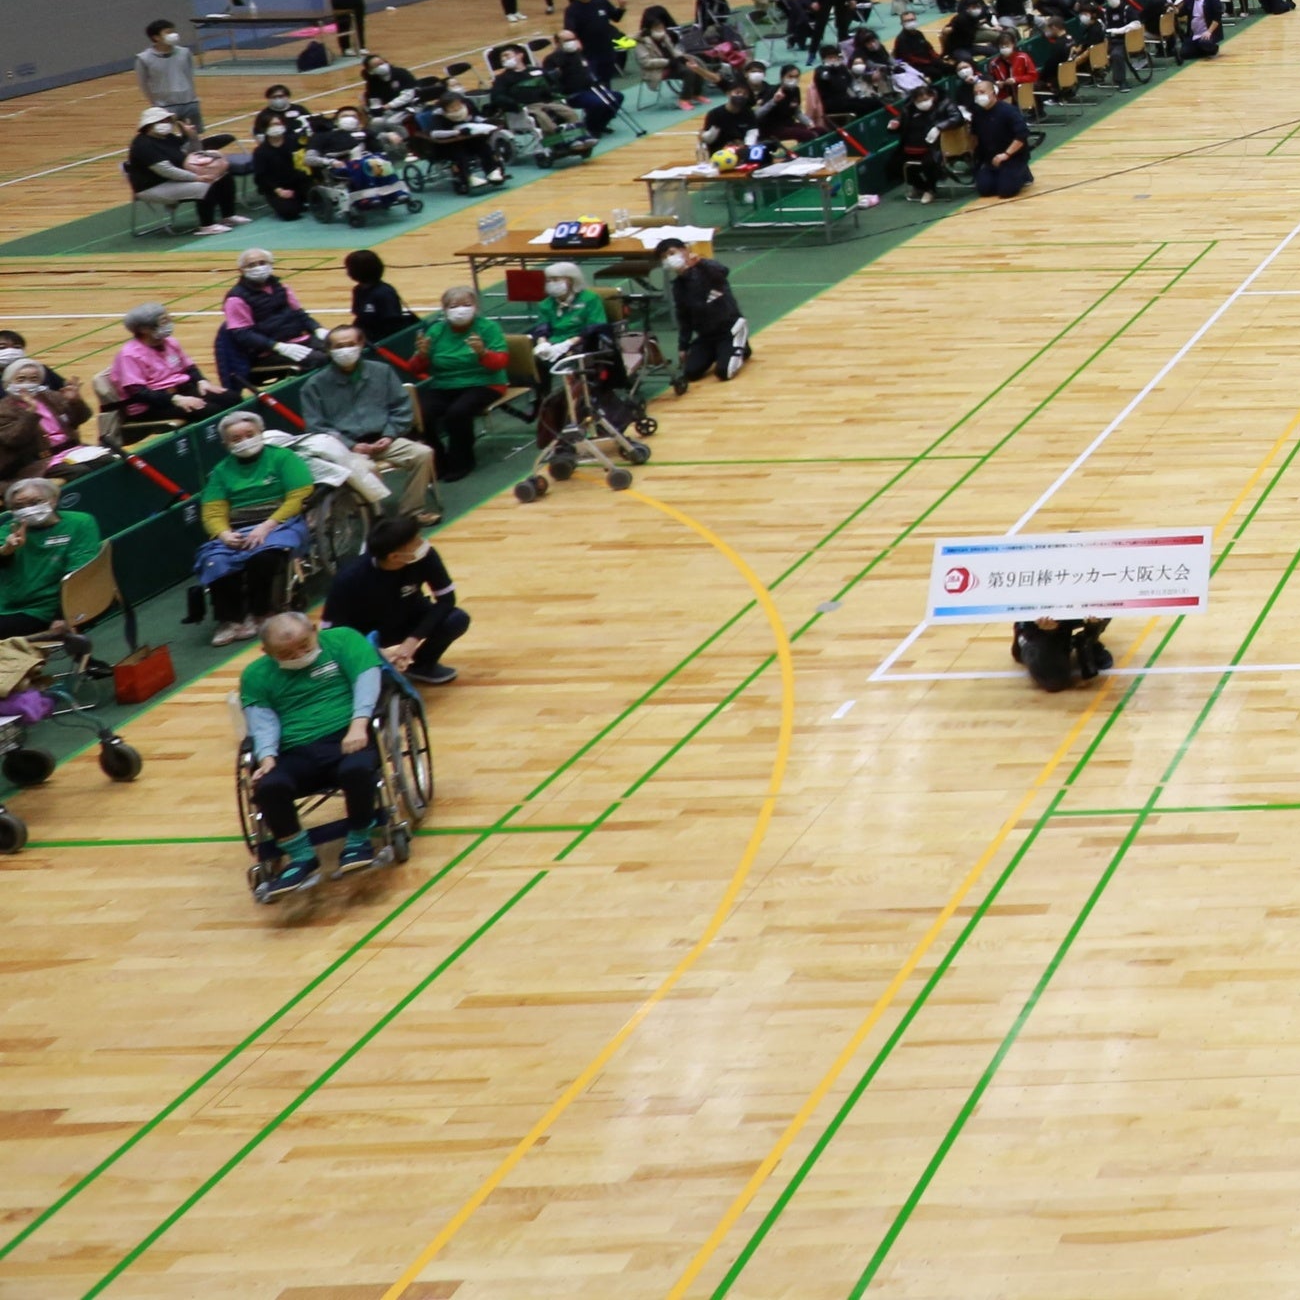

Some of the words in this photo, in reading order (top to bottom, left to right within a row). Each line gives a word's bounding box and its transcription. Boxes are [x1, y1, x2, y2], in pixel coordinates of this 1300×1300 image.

[987, 563, 1191, 588] 第9回棒サッカー大阪大会
